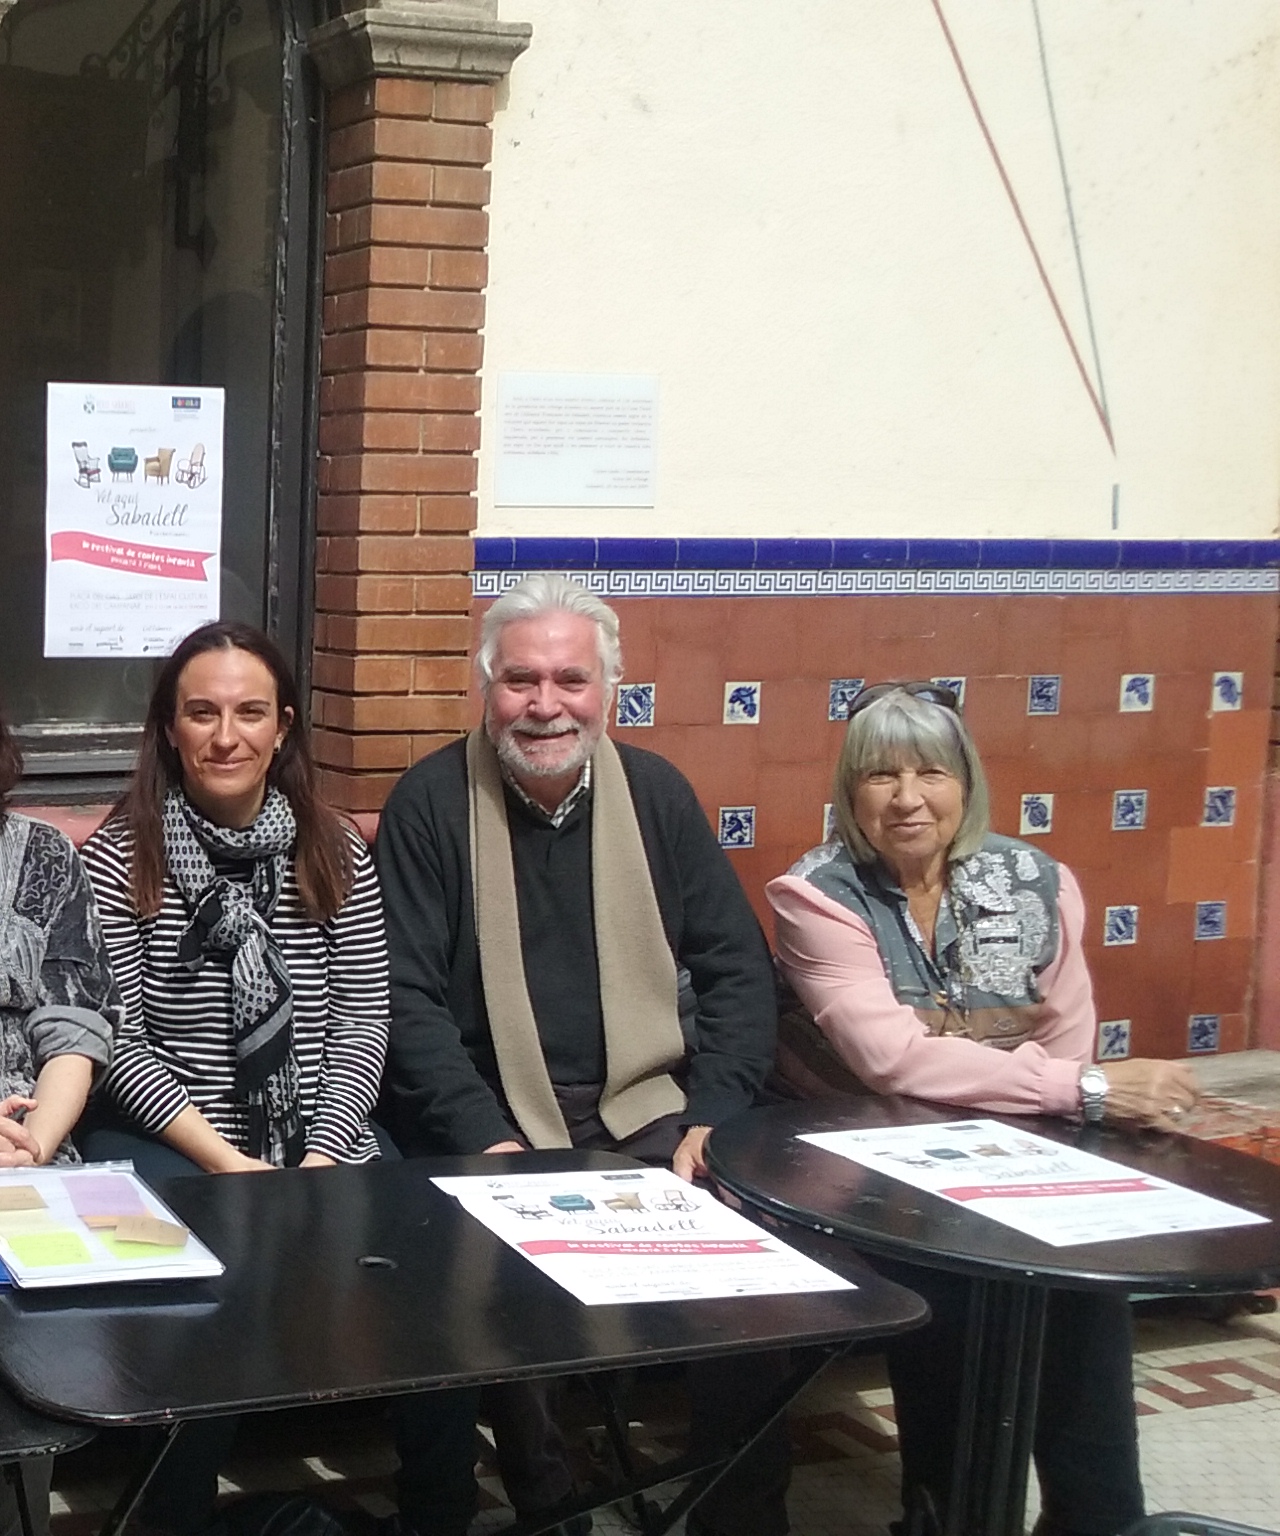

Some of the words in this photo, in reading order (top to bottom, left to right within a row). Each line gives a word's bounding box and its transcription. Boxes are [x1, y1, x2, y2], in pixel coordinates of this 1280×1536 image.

[97, 490, 113, 504] Vet
[106, 504, 190, 527] Sabadell
[586, 1218, 706, 1235] Sabadell
